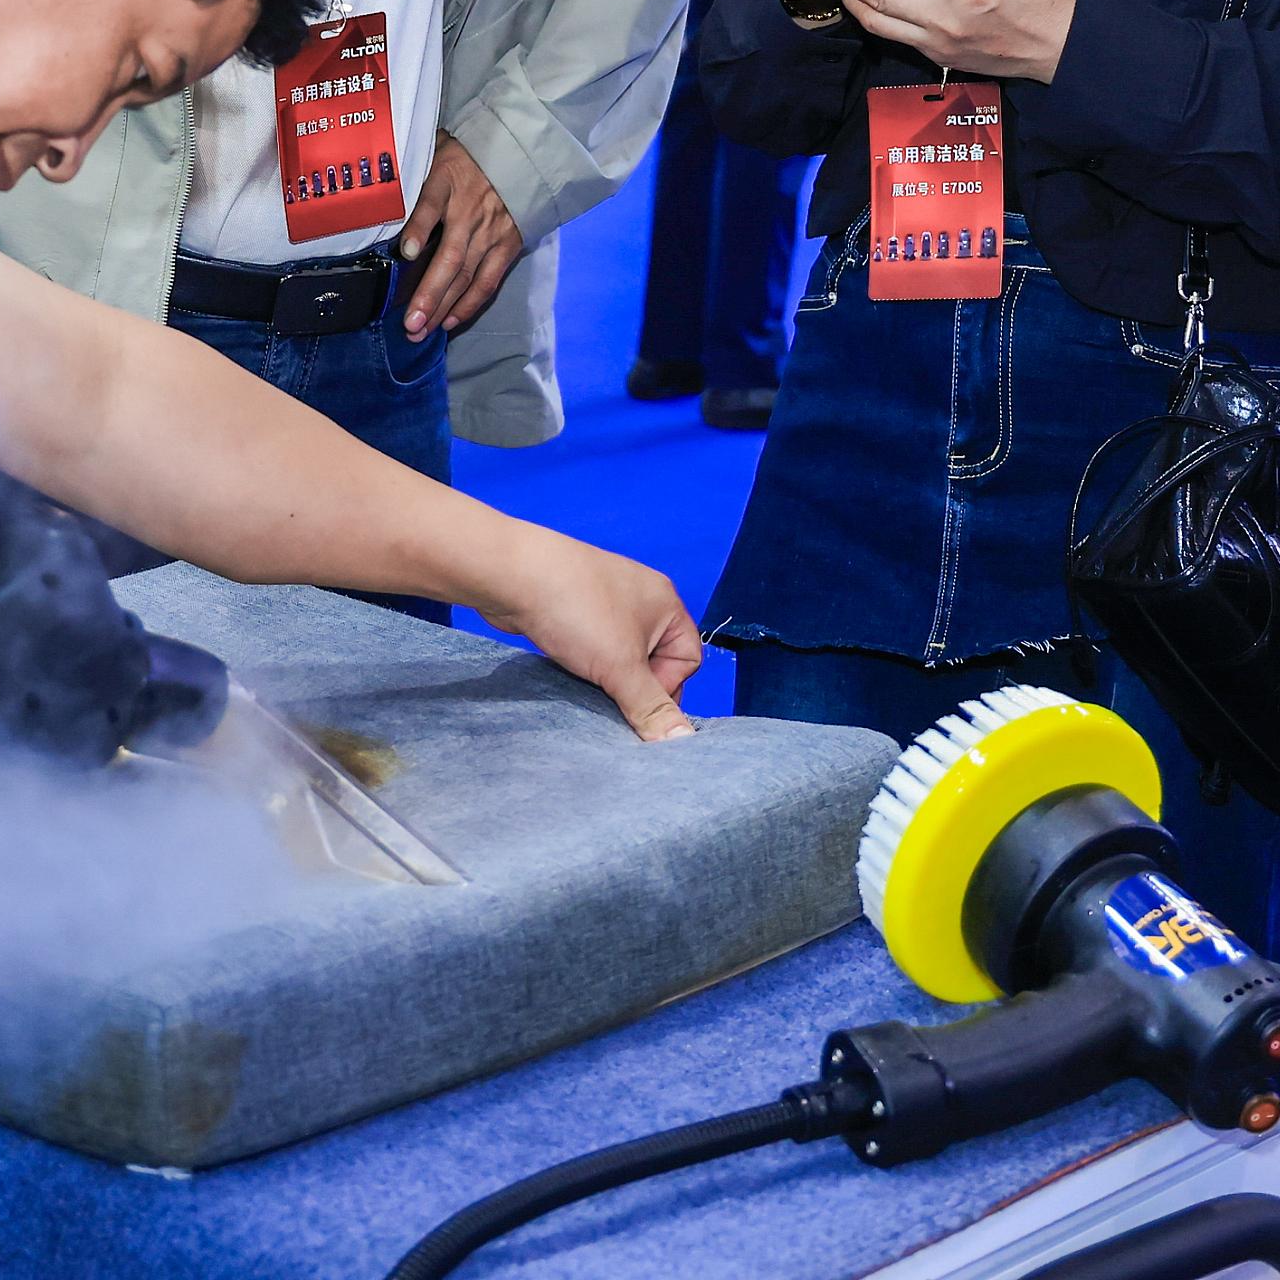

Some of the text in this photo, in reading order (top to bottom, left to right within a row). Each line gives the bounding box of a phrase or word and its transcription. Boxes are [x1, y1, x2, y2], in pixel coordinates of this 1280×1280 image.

[340, 43, 385, 60] ALTON
[290, 73, 374, 105] 商用清洁设备
[946, 115, 998, 126] ALTON
[888, 143, 985, 164] 商用清洁设备
